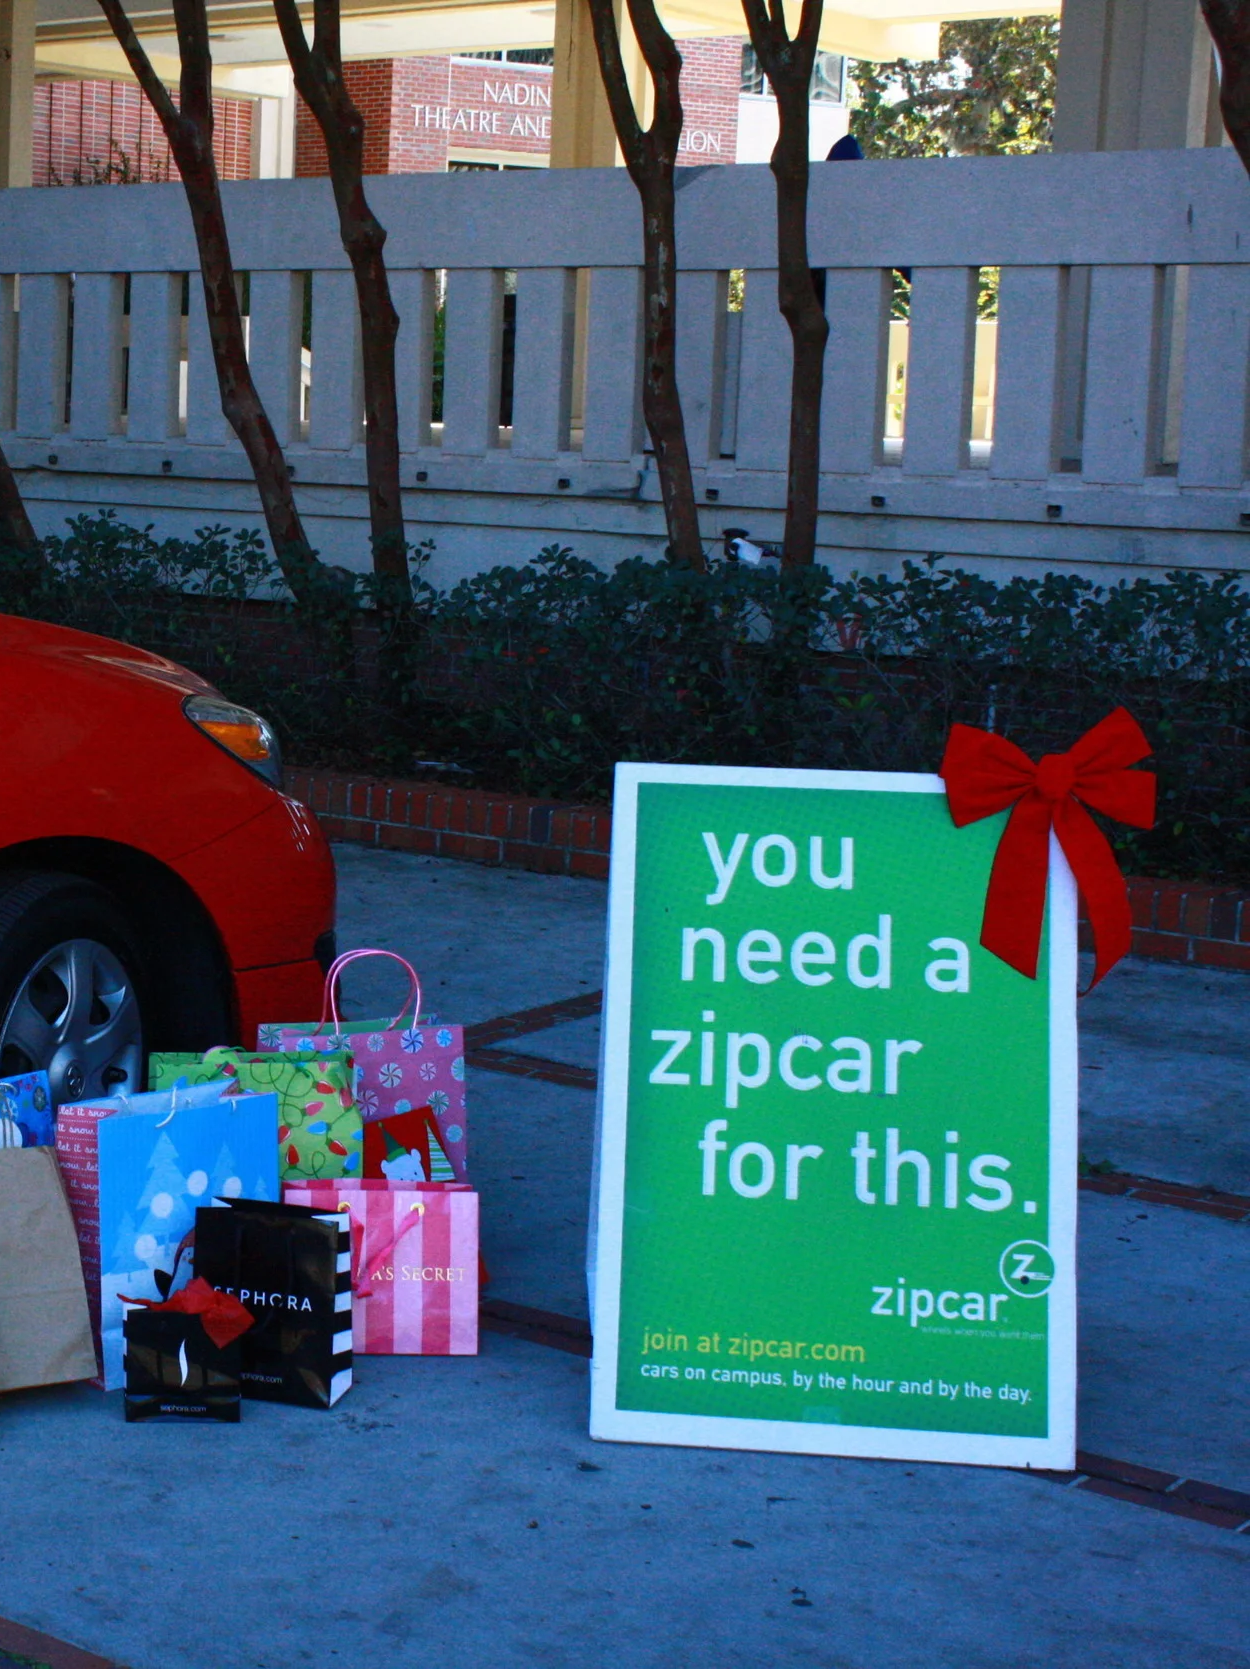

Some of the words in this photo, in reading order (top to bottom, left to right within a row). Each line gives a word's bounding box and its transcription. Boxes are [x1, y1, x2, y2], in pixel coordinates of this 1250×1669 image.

[411, 104, 501, 135] THEATRE
[510, 113, 551, 138] AND
[701, 832, 854, 905] you
[681, 914, 892, 989] need
[924, 936, 970, 993] a
[649, 1010, 923, 1108] zipcar
[698, 1119, 824, 1200] for
[851, 1127, 1037, 1213] this.
[401, 1264, 467, 1281] SECRET
[870, 1278, 1009, 1328] zipcar
[641, 1327, 688, 1355] join
[697, 1333, 721, 1354] at
[727, 1332, 867, 1363] zipcar.com
[640, 1363, 679, 1379] cars
[684, 1367, 706, 1380] on
[793, 1370, 813, 1392] by
[818, 1373, 847, 1390] the
[851, 1374, 895, 1393] hour
[899, 1379, 933, 1396] and
[938, 1379, 959, 1400] by
[964, 1382, 993, 1399] the
[998, 1383, 1033, 1405] day.
